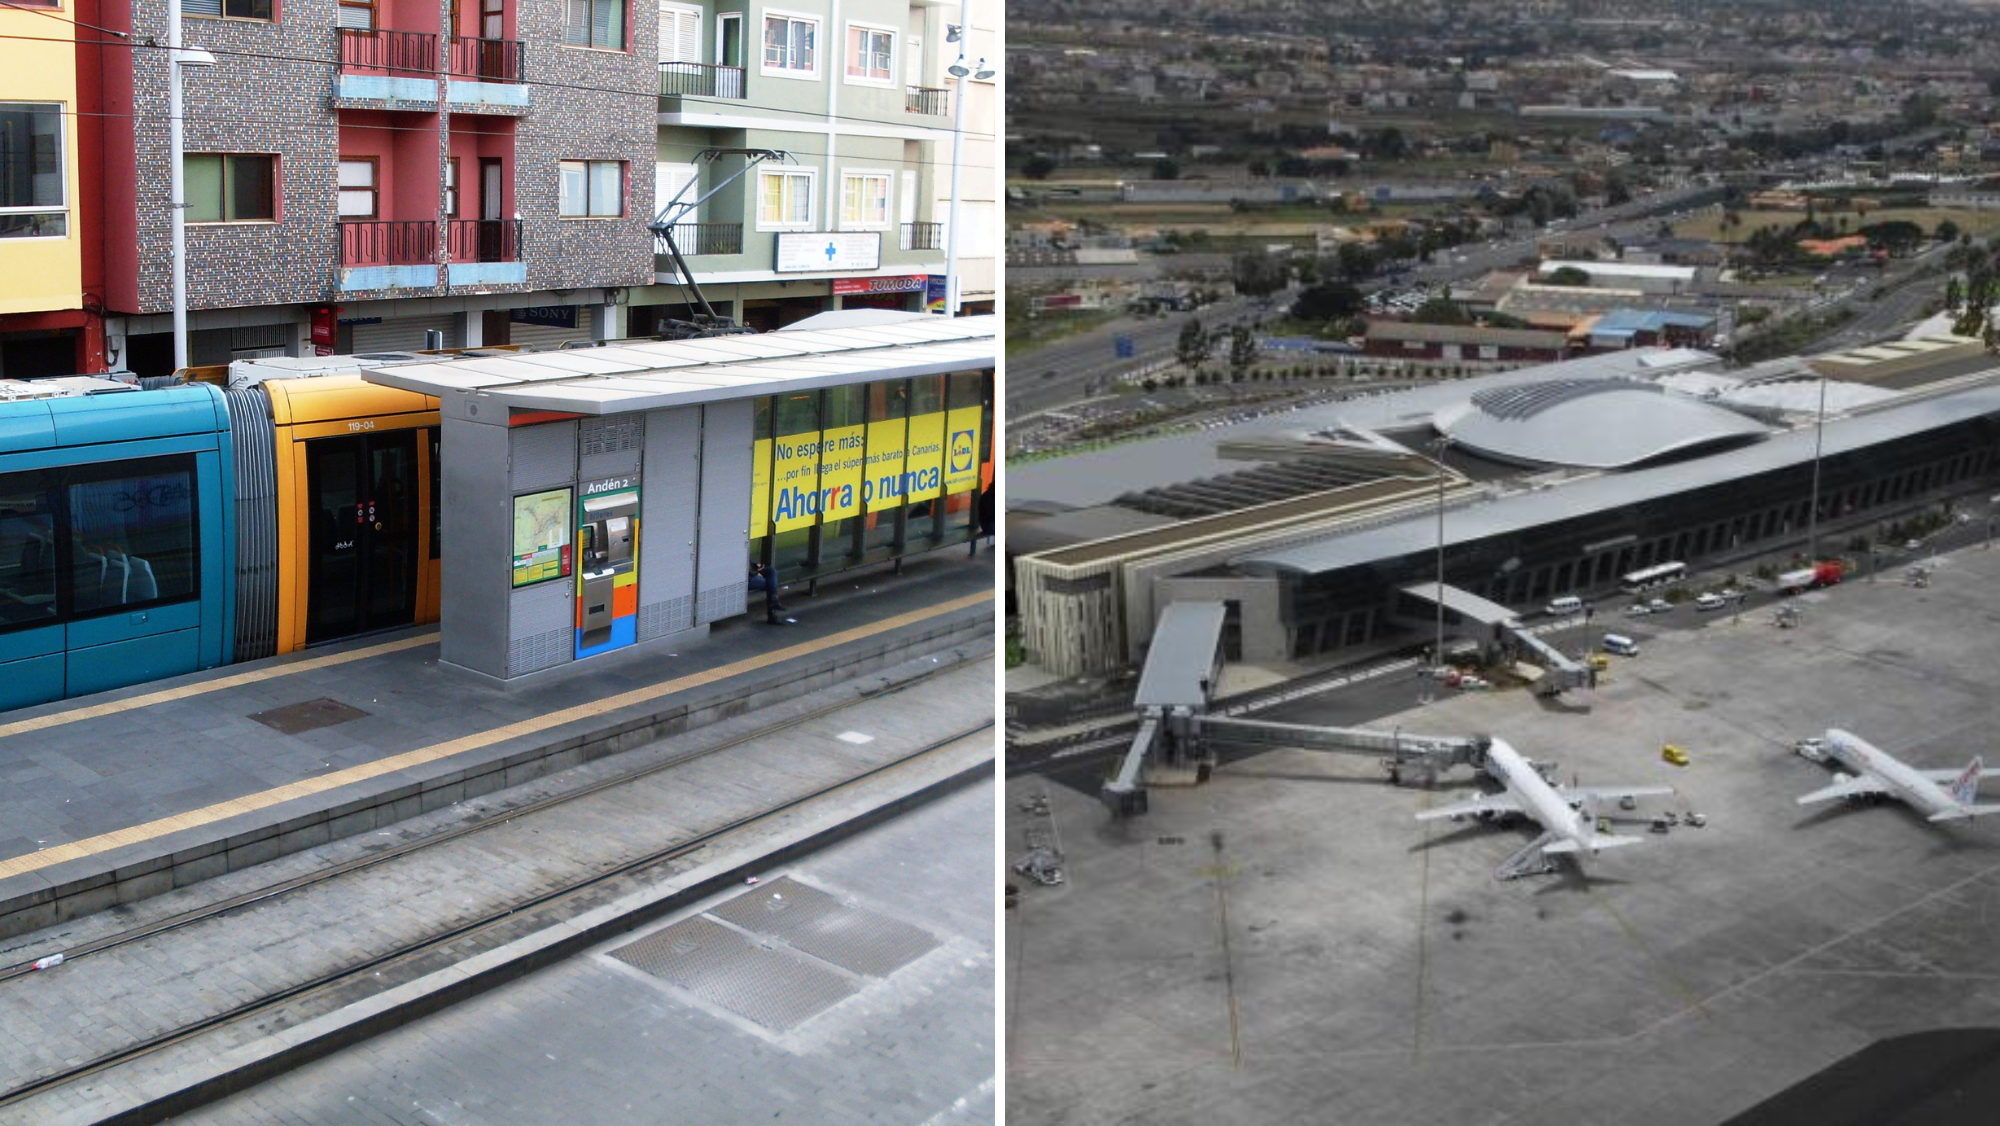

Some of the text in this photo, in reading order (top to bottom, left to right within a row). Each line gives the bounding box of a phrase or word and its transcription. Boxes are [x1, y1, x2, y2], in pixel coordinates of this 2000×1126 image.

[868, 277, 921, 291] TUMODA
[529, 307, 570, 320] SONY
[348, 421, 374, 431] 119-04
[776, 443, 793, 461] No
[801, 465, 811, 477] fin
[834, 459, 841, 471] el
[882, 450, 903, 462] barato
[587, 478, 629, 494] Andén 2
[775, 466, 939, 523] Ahorra o nunca
